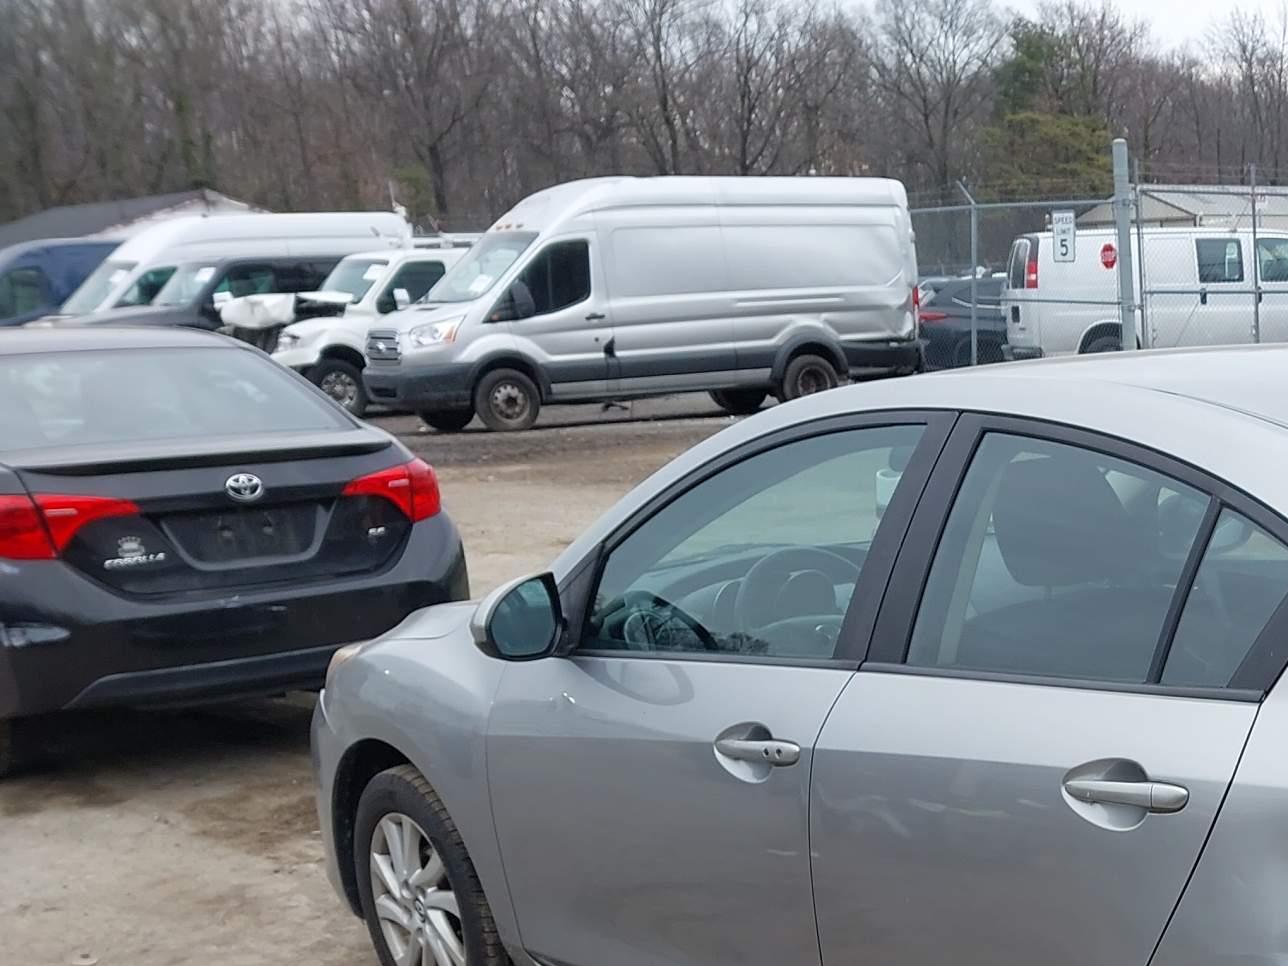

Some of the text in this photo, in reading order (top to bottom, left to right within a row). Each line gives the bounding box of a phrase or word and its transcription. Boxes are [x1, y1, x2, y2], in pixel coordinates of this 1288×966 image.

[1054, 216, 1073, 225] SPEED
[1055, 226, 1072, 236] LIMIT
[1060, 238, 1069, 257] 5
